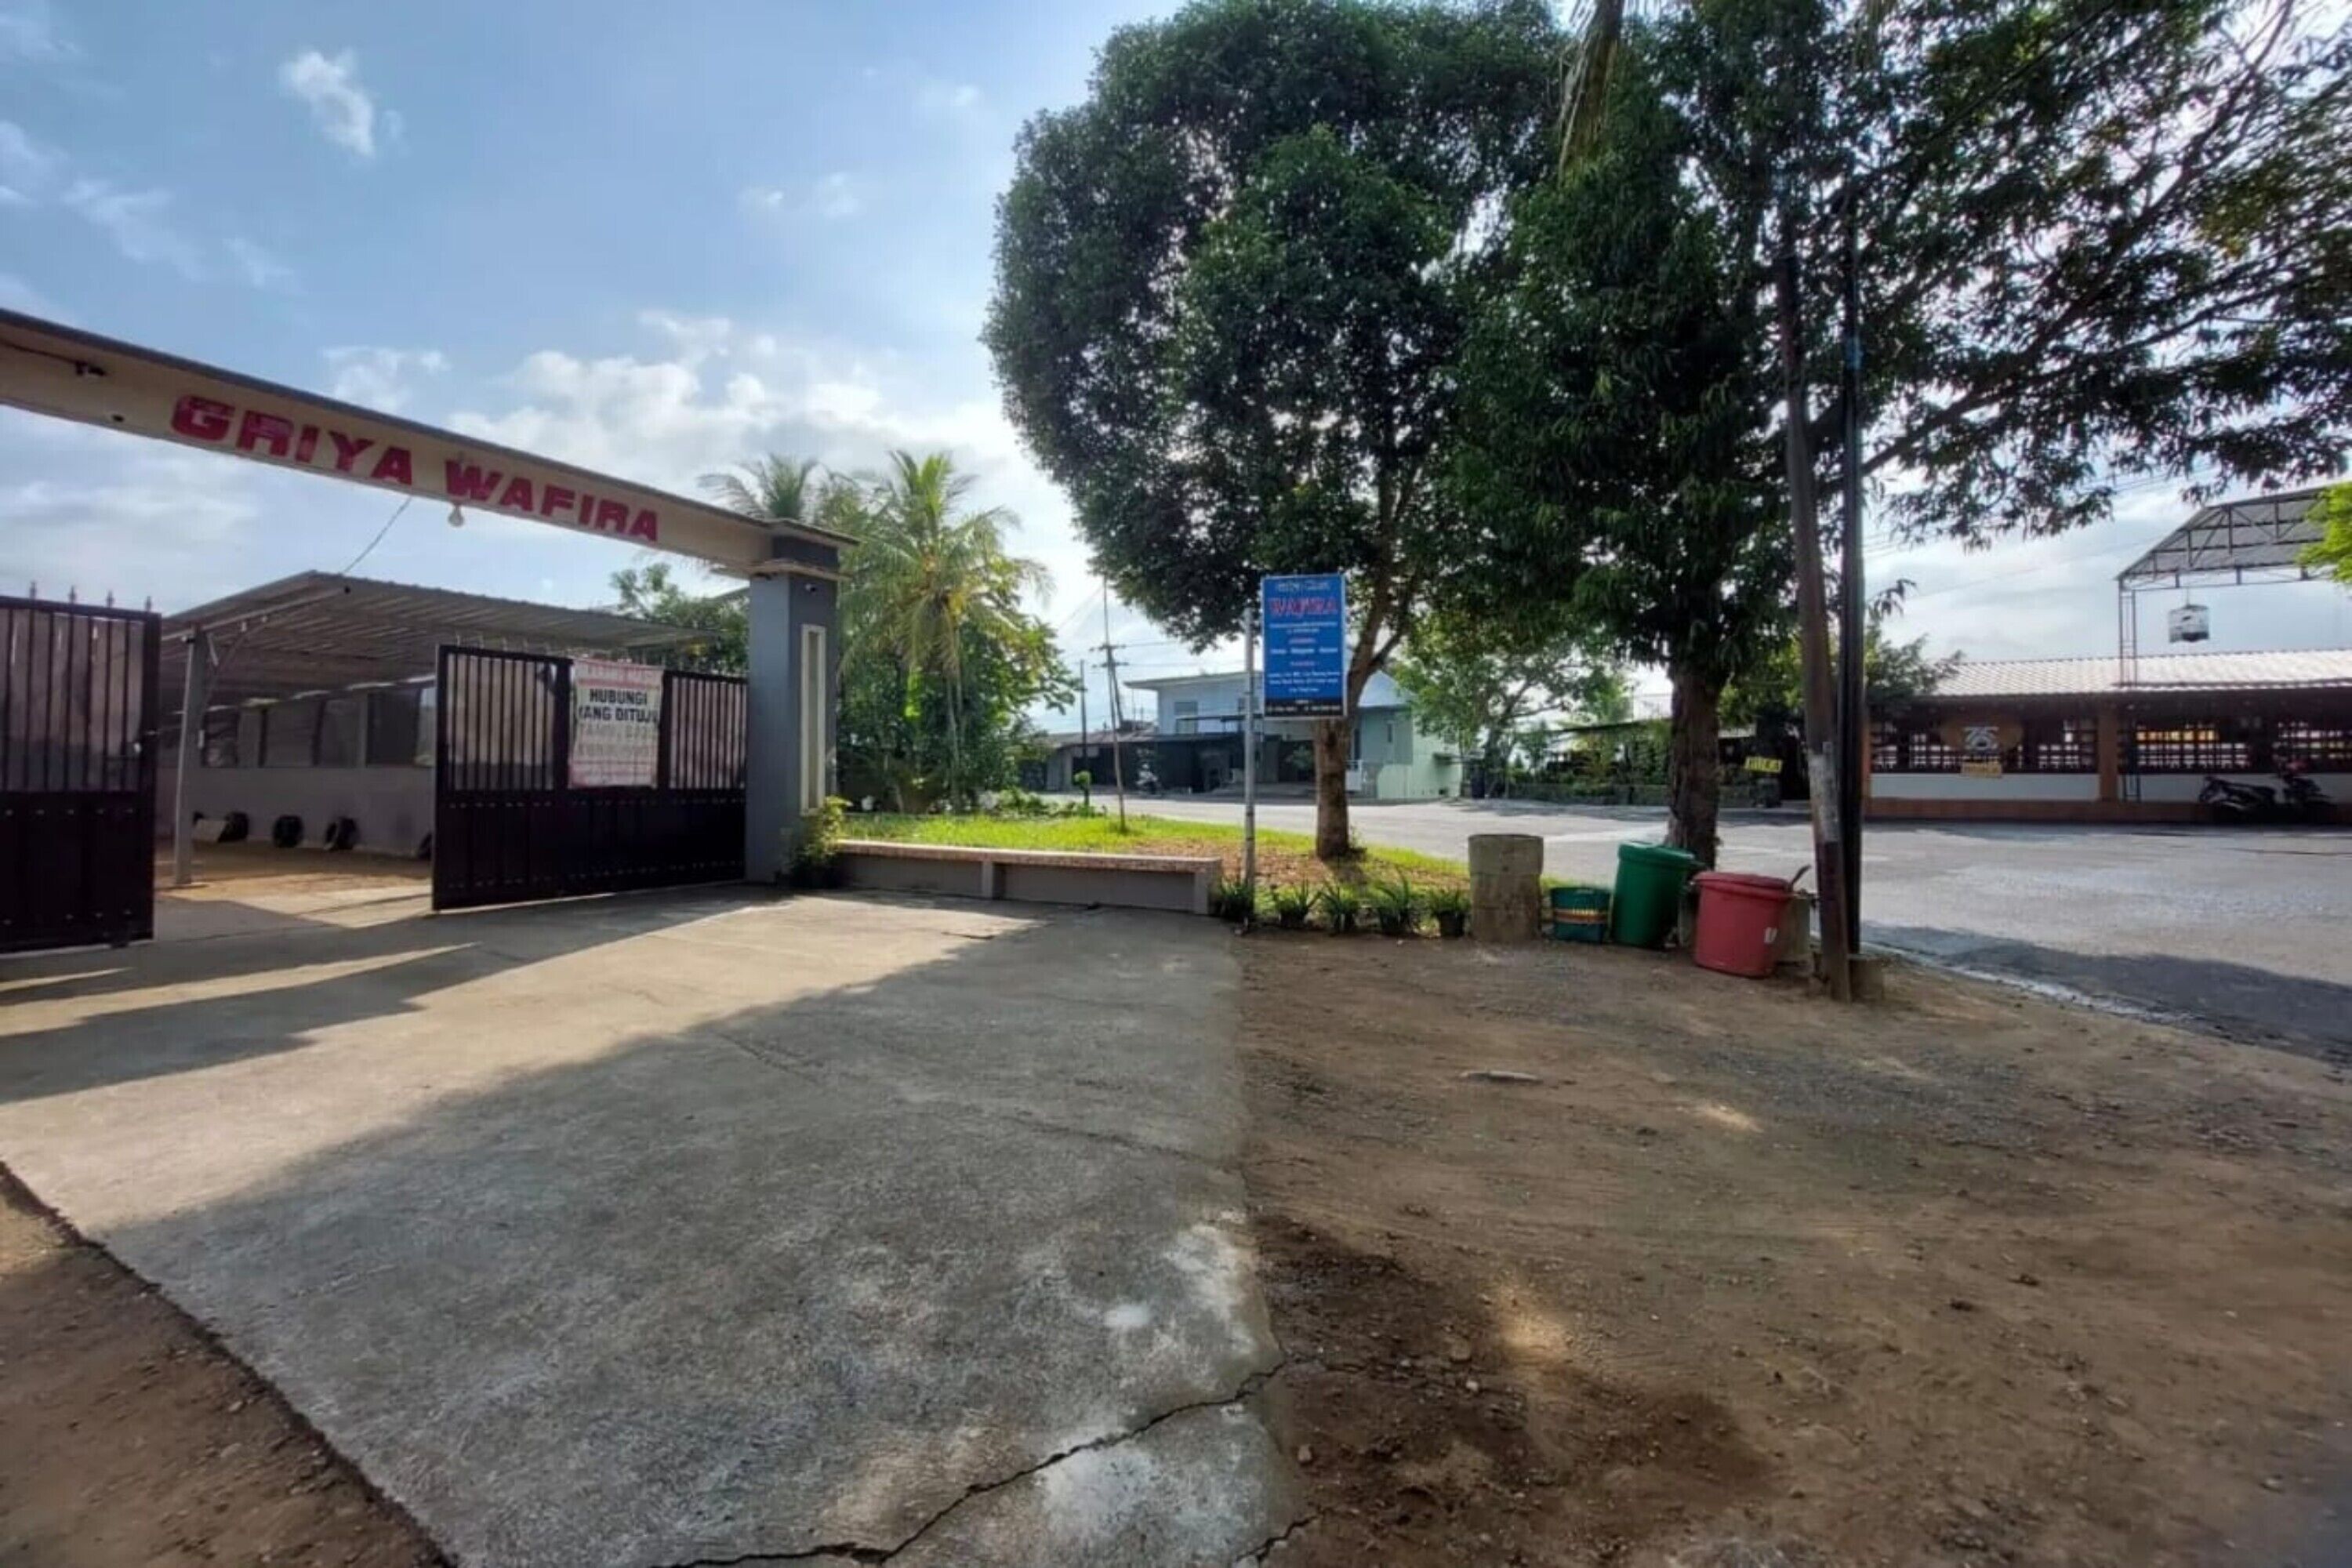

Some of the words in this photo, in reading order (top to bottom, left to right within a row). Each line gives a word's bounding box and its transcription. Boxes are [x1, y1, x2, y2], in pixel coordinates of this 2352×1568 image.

[171, 394, 413, 486] GRIYA
[444, 459, 659, 543] WAFIRA
[590, 688, 648, 705] HUBUNGI
